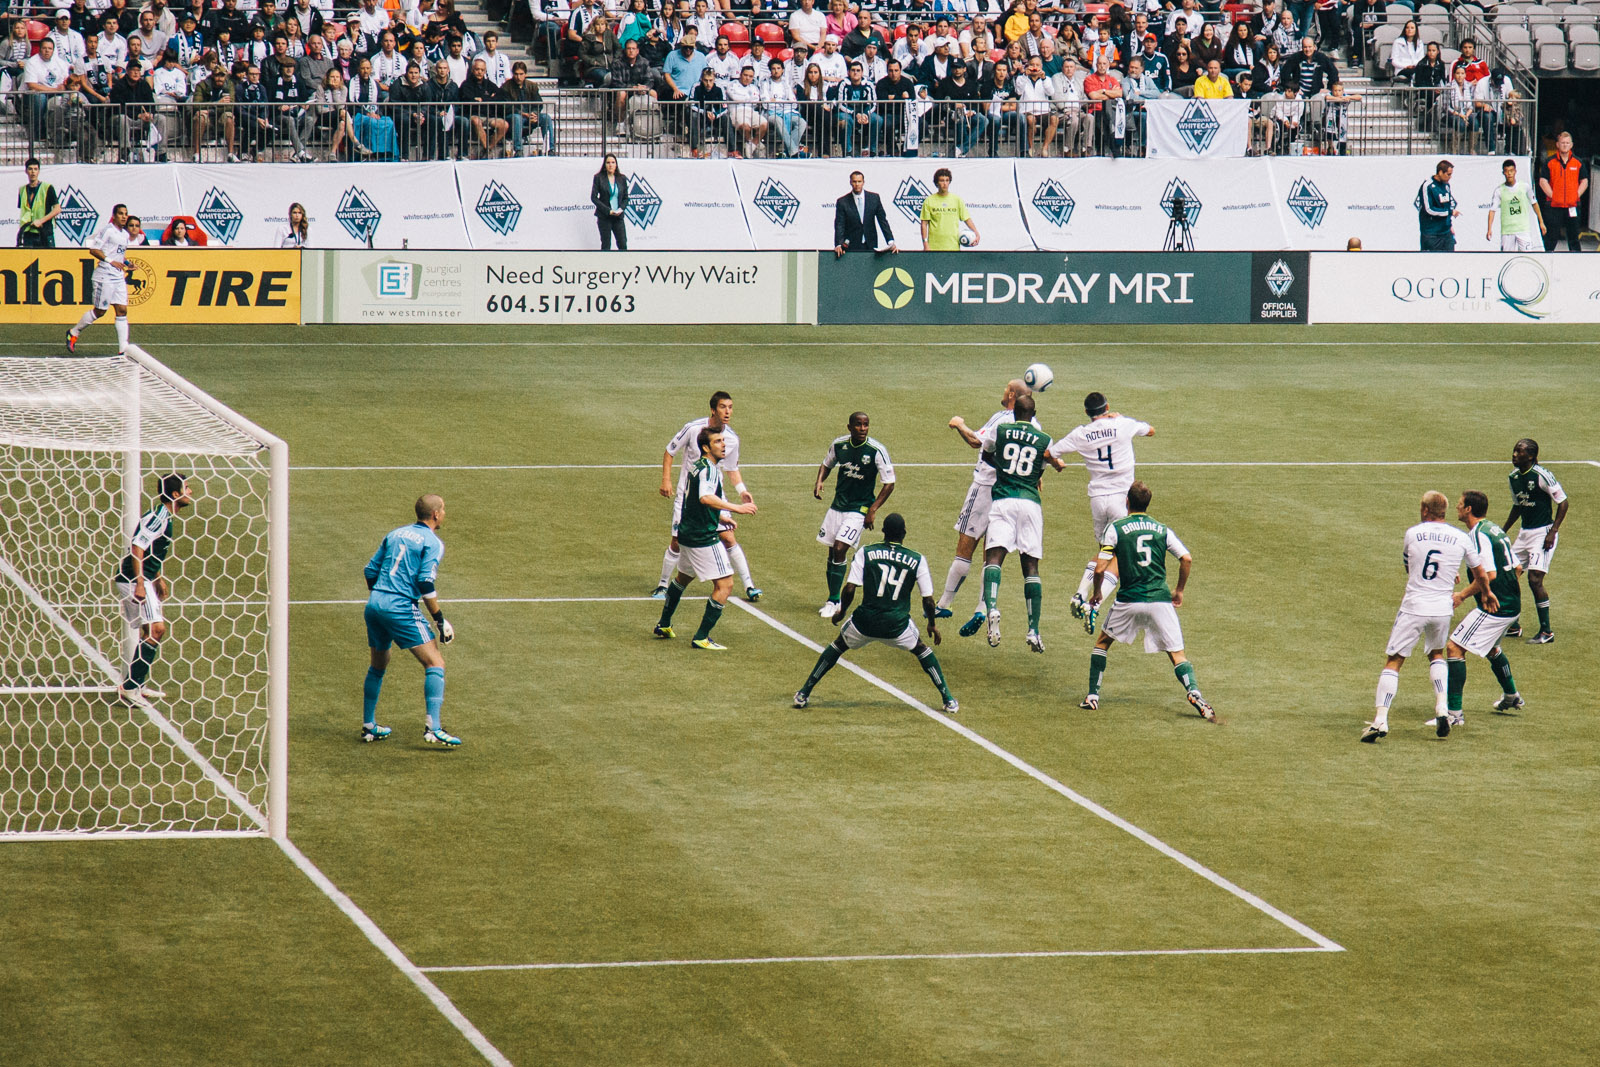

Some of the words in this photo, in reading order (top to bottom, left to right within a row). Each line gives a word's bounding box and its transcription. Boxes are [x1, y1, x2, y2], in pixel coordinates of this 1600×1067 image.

[476, 205, 520, 213] WHITECAPS
[1222, 202, 1271, 210] whitecapsfc.com
[403, 212, 454, 220] whitecapsfc.com
[426, 264, 462, 276] surgical
[486, 264, 544, 284] Need
[552, 264, 640, 289] Surgery?
[646, 264, 696, 290] Why
[700, 264, 758, 284] Wait?
[166, 270, 292, 306] TIRE
[424, 278, 462, 287] centres
[924, 272, 1101, 304] MEDRAY
[1108, 272, 1194, 304] MRI
[1392, 276, 1493, 302] QGOLF
[390, 309, 462, 317] westminster
[486, 294, 636, 313] 604.517.1063
[1448, 302, 1492, 311] CLUB
[1006, 430, 1039, 445] FUTTY
[1002, 443, 1038, 477] 98
[1097, 445, 1114, 470] 4
[841, 525, 857, 540] 30
[1121, 521, 1164, 535] BRUNNER
[1416, 532, 1458, 546] DEMERIT
[390, 544, 406, 576] 1
[867, 549, 918, 570] MARCELIN
[1136, 534, 1153, 567] 5
[1422, 549, 1442, 580] 6
[876, 563, 908, 600] 14
